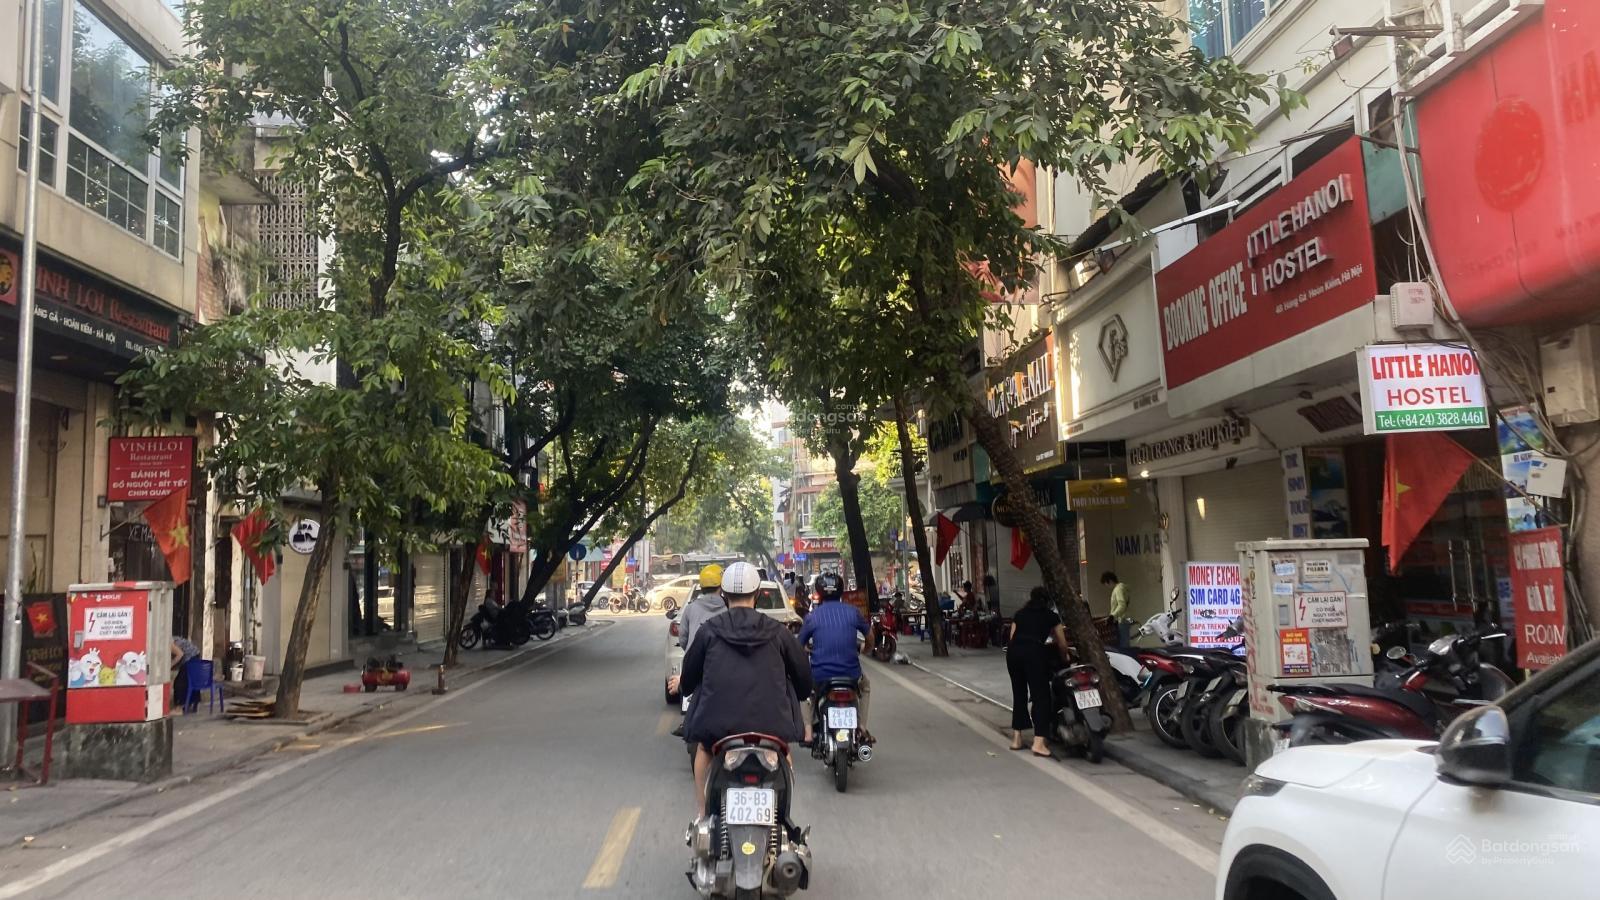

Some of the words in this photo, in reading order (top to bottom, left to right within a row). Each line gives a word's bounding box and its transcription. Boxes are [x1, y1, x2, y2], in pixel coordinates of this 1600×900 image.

[1290, 174, 1352, 232] HANOI
[1262, 238, 1327, 292] HOSTEL
[37, 265, 70, 305] INH
[1163, 285, 1208, 350] BOOKING
[1208, 261, 1248, 328] OFFICE
[1371, 353, 1423, 380] LITTLE
[1387, 386, 1472, 407] HOSTEL
[1436, 412, 1460, 426] 3828
[1461, 411, 1484, 425] 4461
[1184, 433, 1195, 453] &
[130, 453, 173, 461] Restaurant
[131, 469, 157, 479] BÁNH
[1115, 535, 1141, 556] NAM
[1189, 565, 1214, 586] MONEY
[1190, 588, 1205, 605] SIM
[1208, 588, 1228, 605] CARD
[729, 807, 771, 822] 402.69
